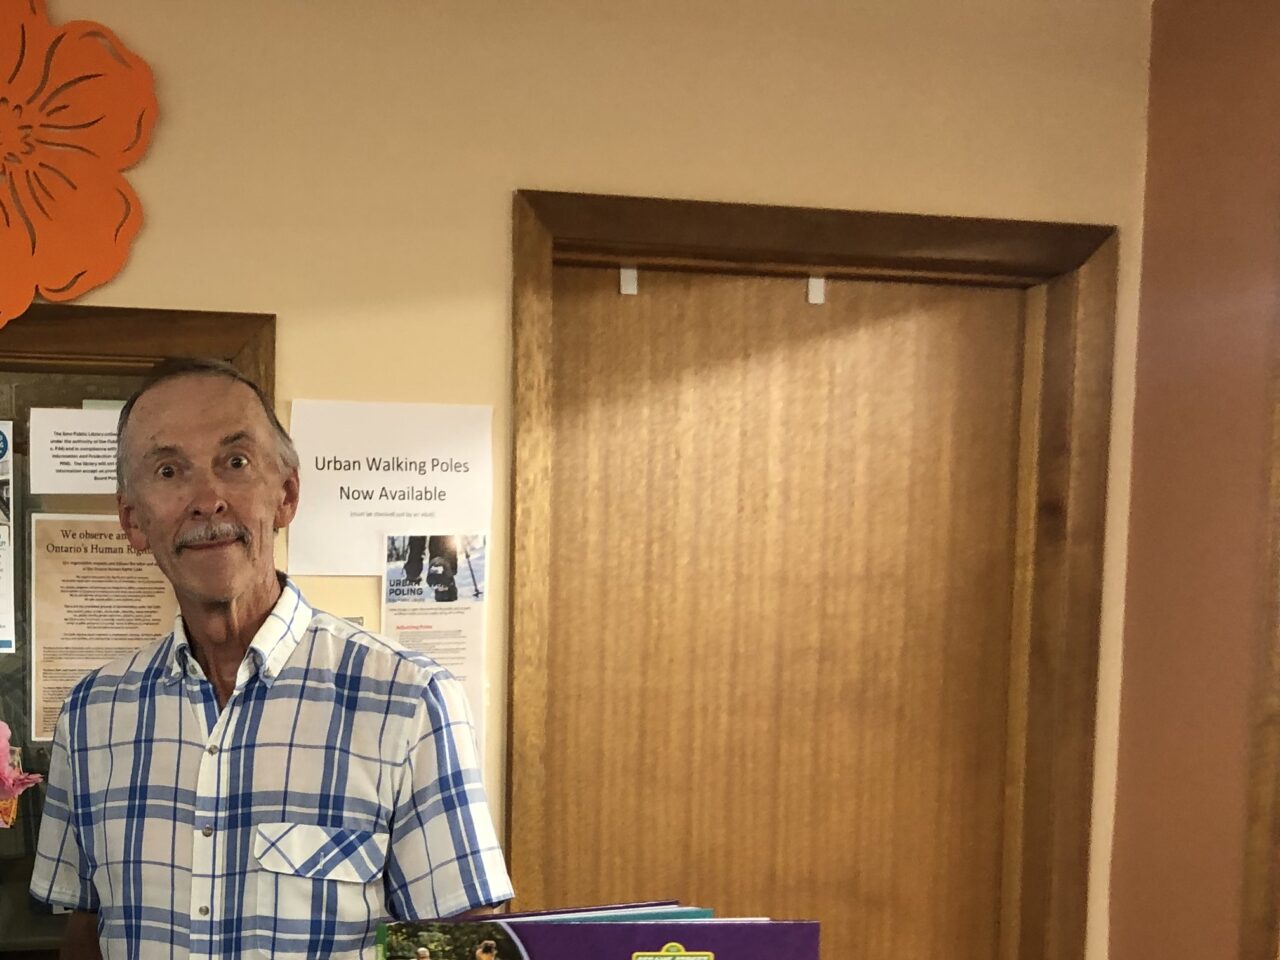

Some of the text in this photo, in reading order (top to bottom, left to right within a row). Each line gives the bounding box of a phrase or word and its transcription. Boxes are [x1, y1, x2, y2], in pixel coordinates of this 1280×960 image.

[315, 456, 470, 475] Urban Walking Poles
[339, 486, 447, 501] Now Available
[61, 529, 77, 540] We
[79, 530, 114, 540] observe
[46, 543, 89, 554] Ontario's
[90, 543, 124, 554] Human
[389, 579, 421, 588] URBAN
[389, 588, 423, 596] POLING
